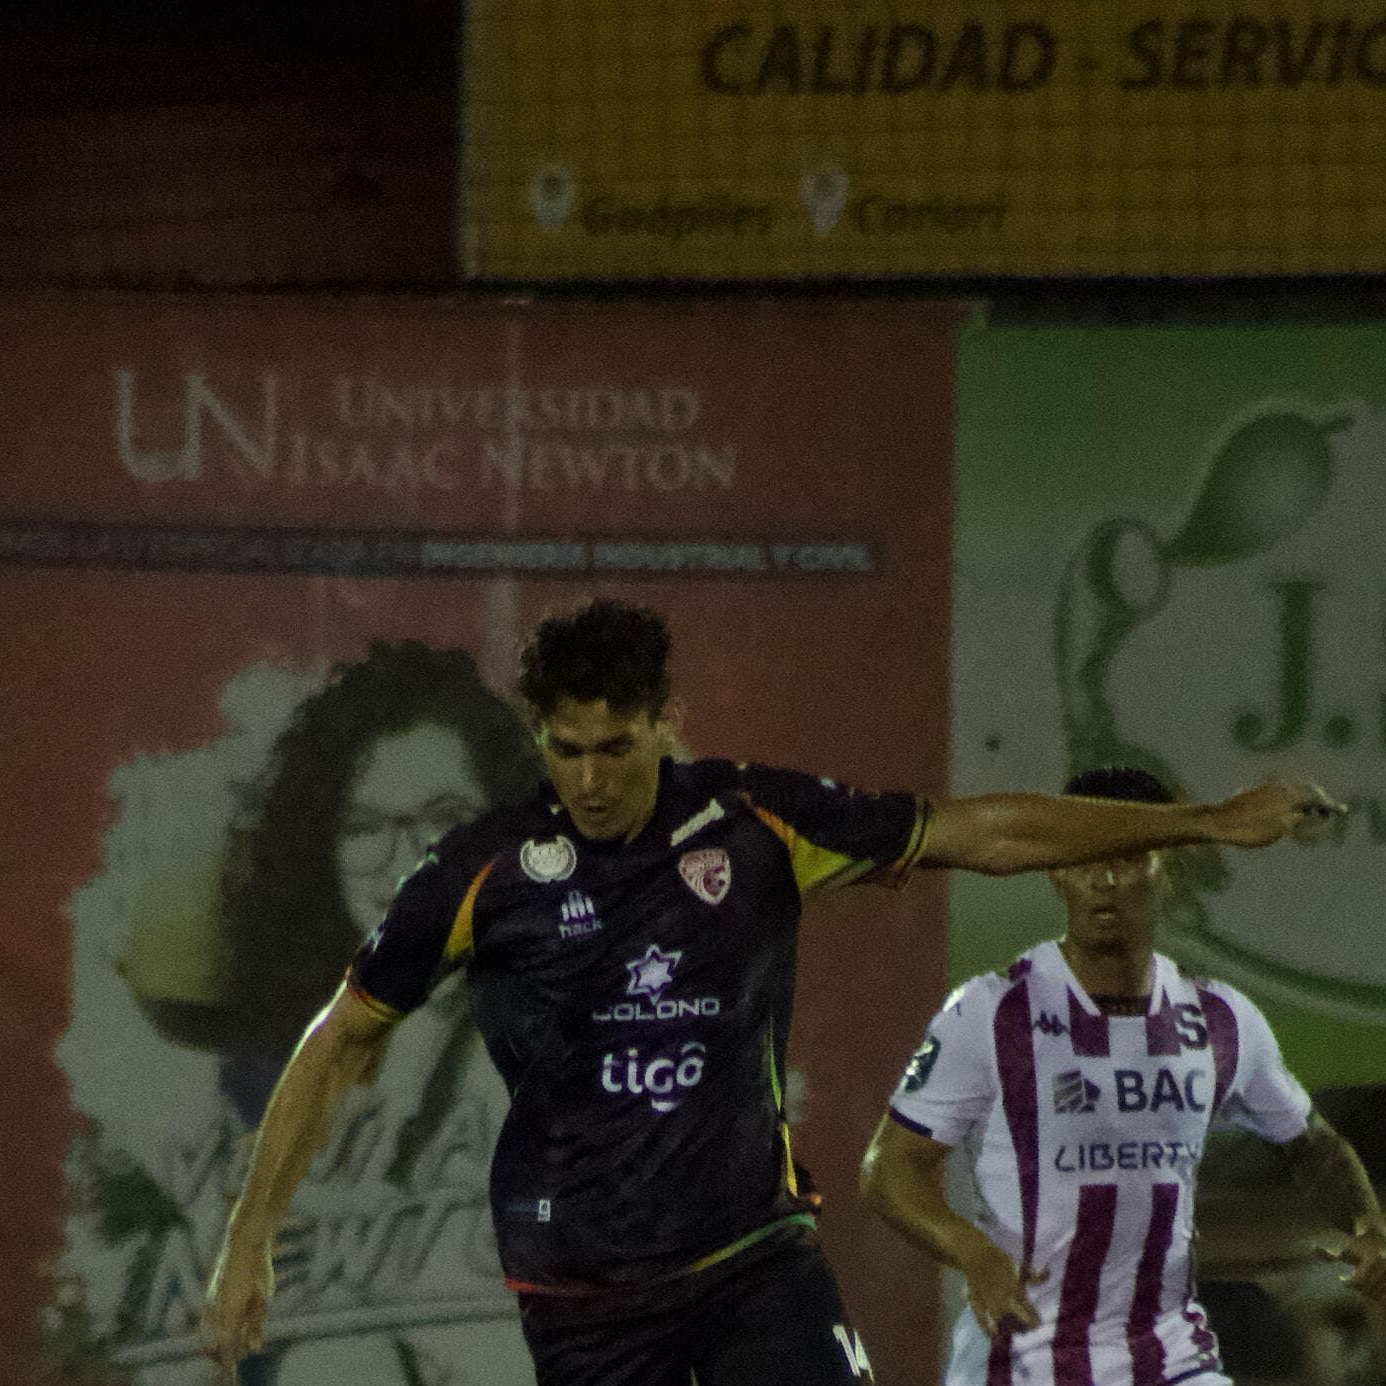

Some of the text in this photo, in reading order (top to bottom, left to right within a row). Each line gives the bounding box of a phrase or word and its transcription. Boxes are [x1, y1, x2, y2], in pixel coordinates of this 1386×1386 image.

[698, 22, 1059, 94] CALIDAD
[479, 439, 739, 493] NEWTON
[1114, 1069, 1208, 1113] BAC
